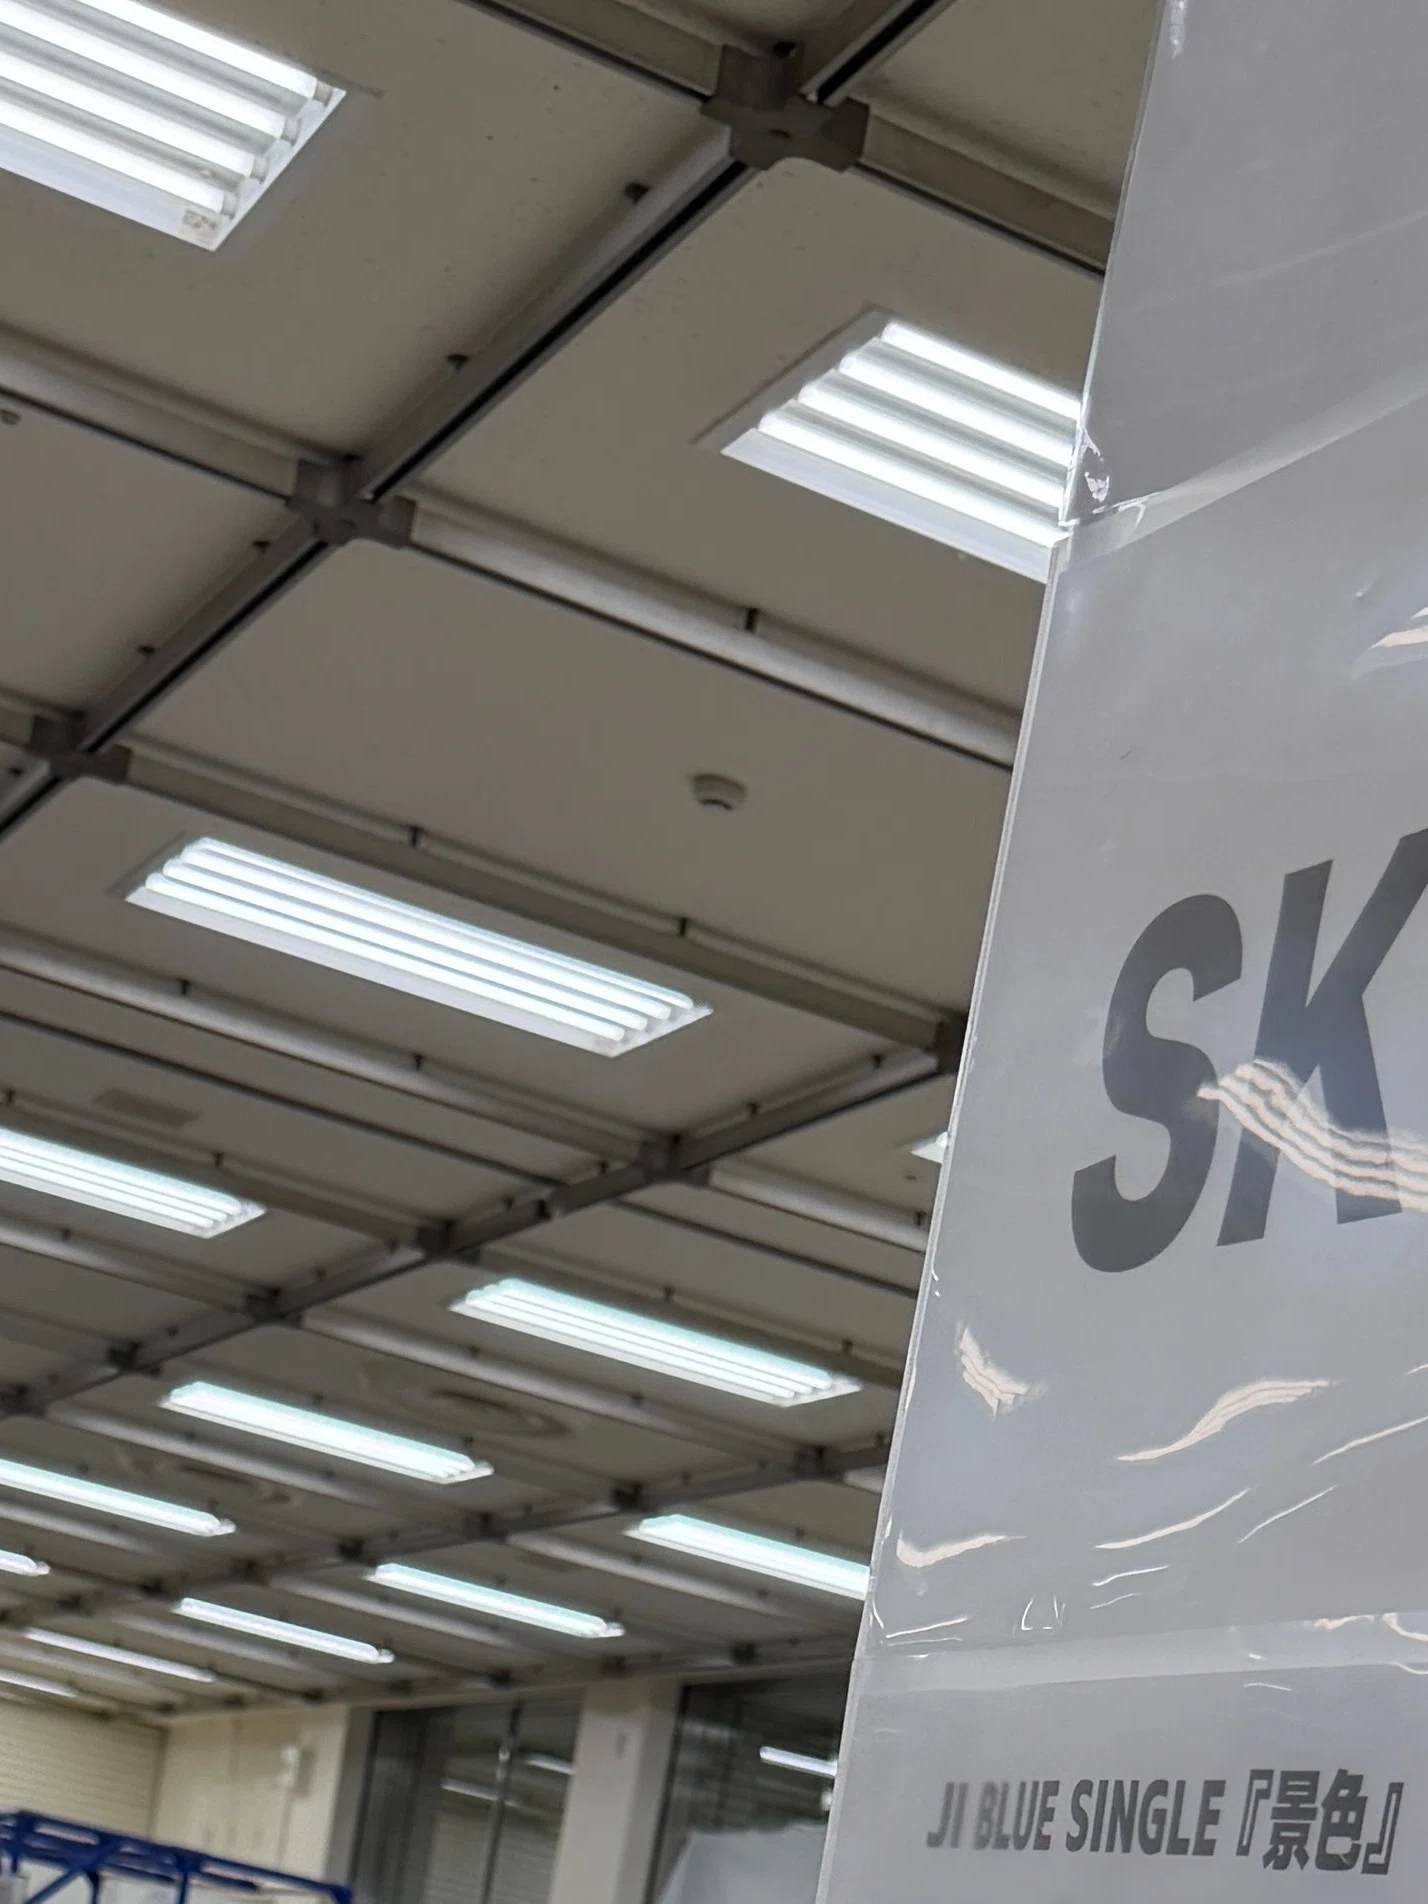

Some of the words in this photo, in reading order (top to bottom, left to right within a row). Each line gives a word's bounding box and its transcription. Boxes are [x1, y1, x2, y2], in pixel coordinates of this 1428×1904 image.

[974, 1779, 1060, 1852] BLUE
[1065, 1778, 1227, 1856] SINGLE
[1235, 1768, 1405, 1875] 『景色』
